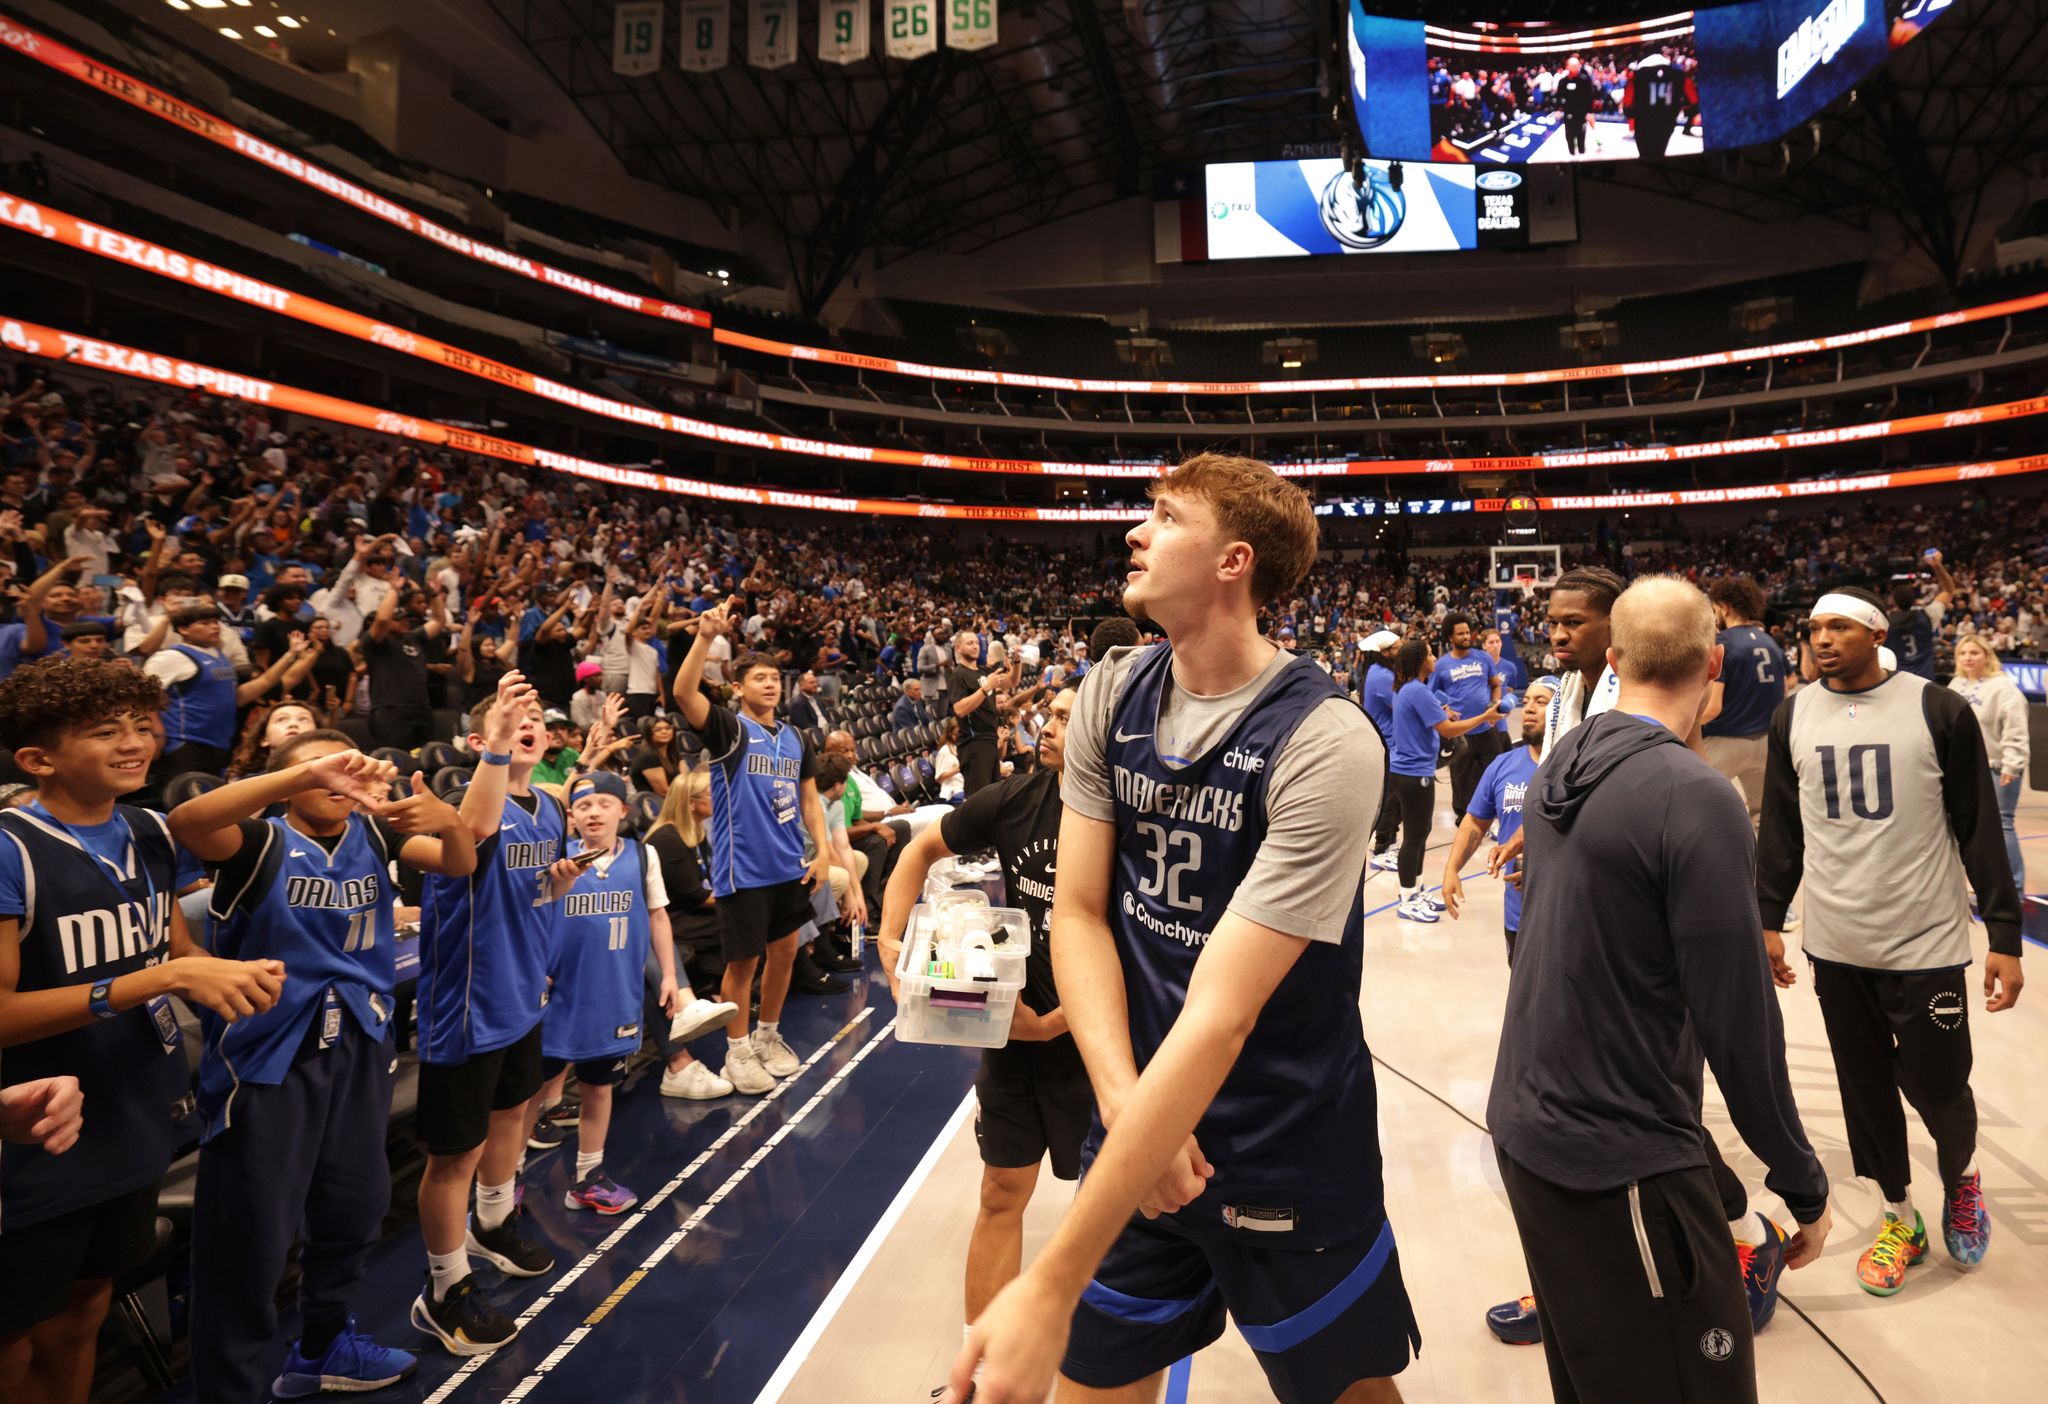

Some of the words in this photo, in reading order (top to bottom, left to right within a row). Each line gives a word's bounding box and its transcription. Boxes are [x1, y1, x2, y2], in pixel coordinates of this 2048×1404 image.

[765, 14, 780, 46] 7
[836, 10, 852, 43] 9
[892, 5, 927, 38] 26
[953, 0, 990, 29] 56
[624, 21, 652, 54] 19
[696, 17, 712, 49] 8
[1649, 82, 1672, 105] 14
[80, 60, 137, 99] THE
[233, 130, 304, 176] TEXAS
[421, 221, 470, 252] TEXAS
[545, 268, 593, 294] TEXAS
[594, 285, 641, 307] SPIRIT
[1483, 195, 1514, 206] TEXAS
[1486, 206, 1512, 217] FORD
[1478, 216, 1520, 230] DEALERS
[77, 223, 188, 276] TEXAS
[193, 264, 288, 309] SPIRIT
[59, 335, 173, 379] TEXAS
[177, 364, 272, 400] SPIRIT
[443, 347, 474, 369] THE
[534, 378, 581, 405] TEXAS
[672, 417, 716, 437] TEXAS
[781, 437, 825, 454] TEXAS
[1471, 460, 1494, 469] THE
[1542, 454, 1586, 467] TEXAS
[1675, 443, 1722, 457] TEXAS
[1787, 431, 1837, 446] TEXAS
[446, 429, 475, 448] THE
[665, 477, 708, 495] TEXAS
[768, 492, 813, 507] TEXAS
[968, 460, 993, 469] THE
[1042, 463, 1084, 474] TEXAS
[1274, 464, 1304, 475] EXAS
[1305, 463, 1349, 474] SPIRIT
[1552, 497, 1596, 508] TEXAS
[1680, 490, 1725, 502] TEXAS
[1789, 481, 1837, 494] TEXAS
[964, 508, 989, 517] THE
[1037, 510, 1078, 520] TEXAS
[1082, 510, 1153, 521] DISTILLERY
[1753, 647, 1775, 683] 2
[746, 753, 801, 779] DALLAS
[1815, 743, 1894, 820] 10
[1113, 765, 1244, 832] MAVERICKS
[1011, 839, 1057, 875] MAVERI
[1136, 821, 1203, 912] 32
[287, 873, 380, 909] DALLAS
[564, 890, 633, 917] DALLAS
[343, 909, 376, 952] 11
[608, 916, 628, 950] 11
[1136, 902, 1211, 947] Crunchyro
